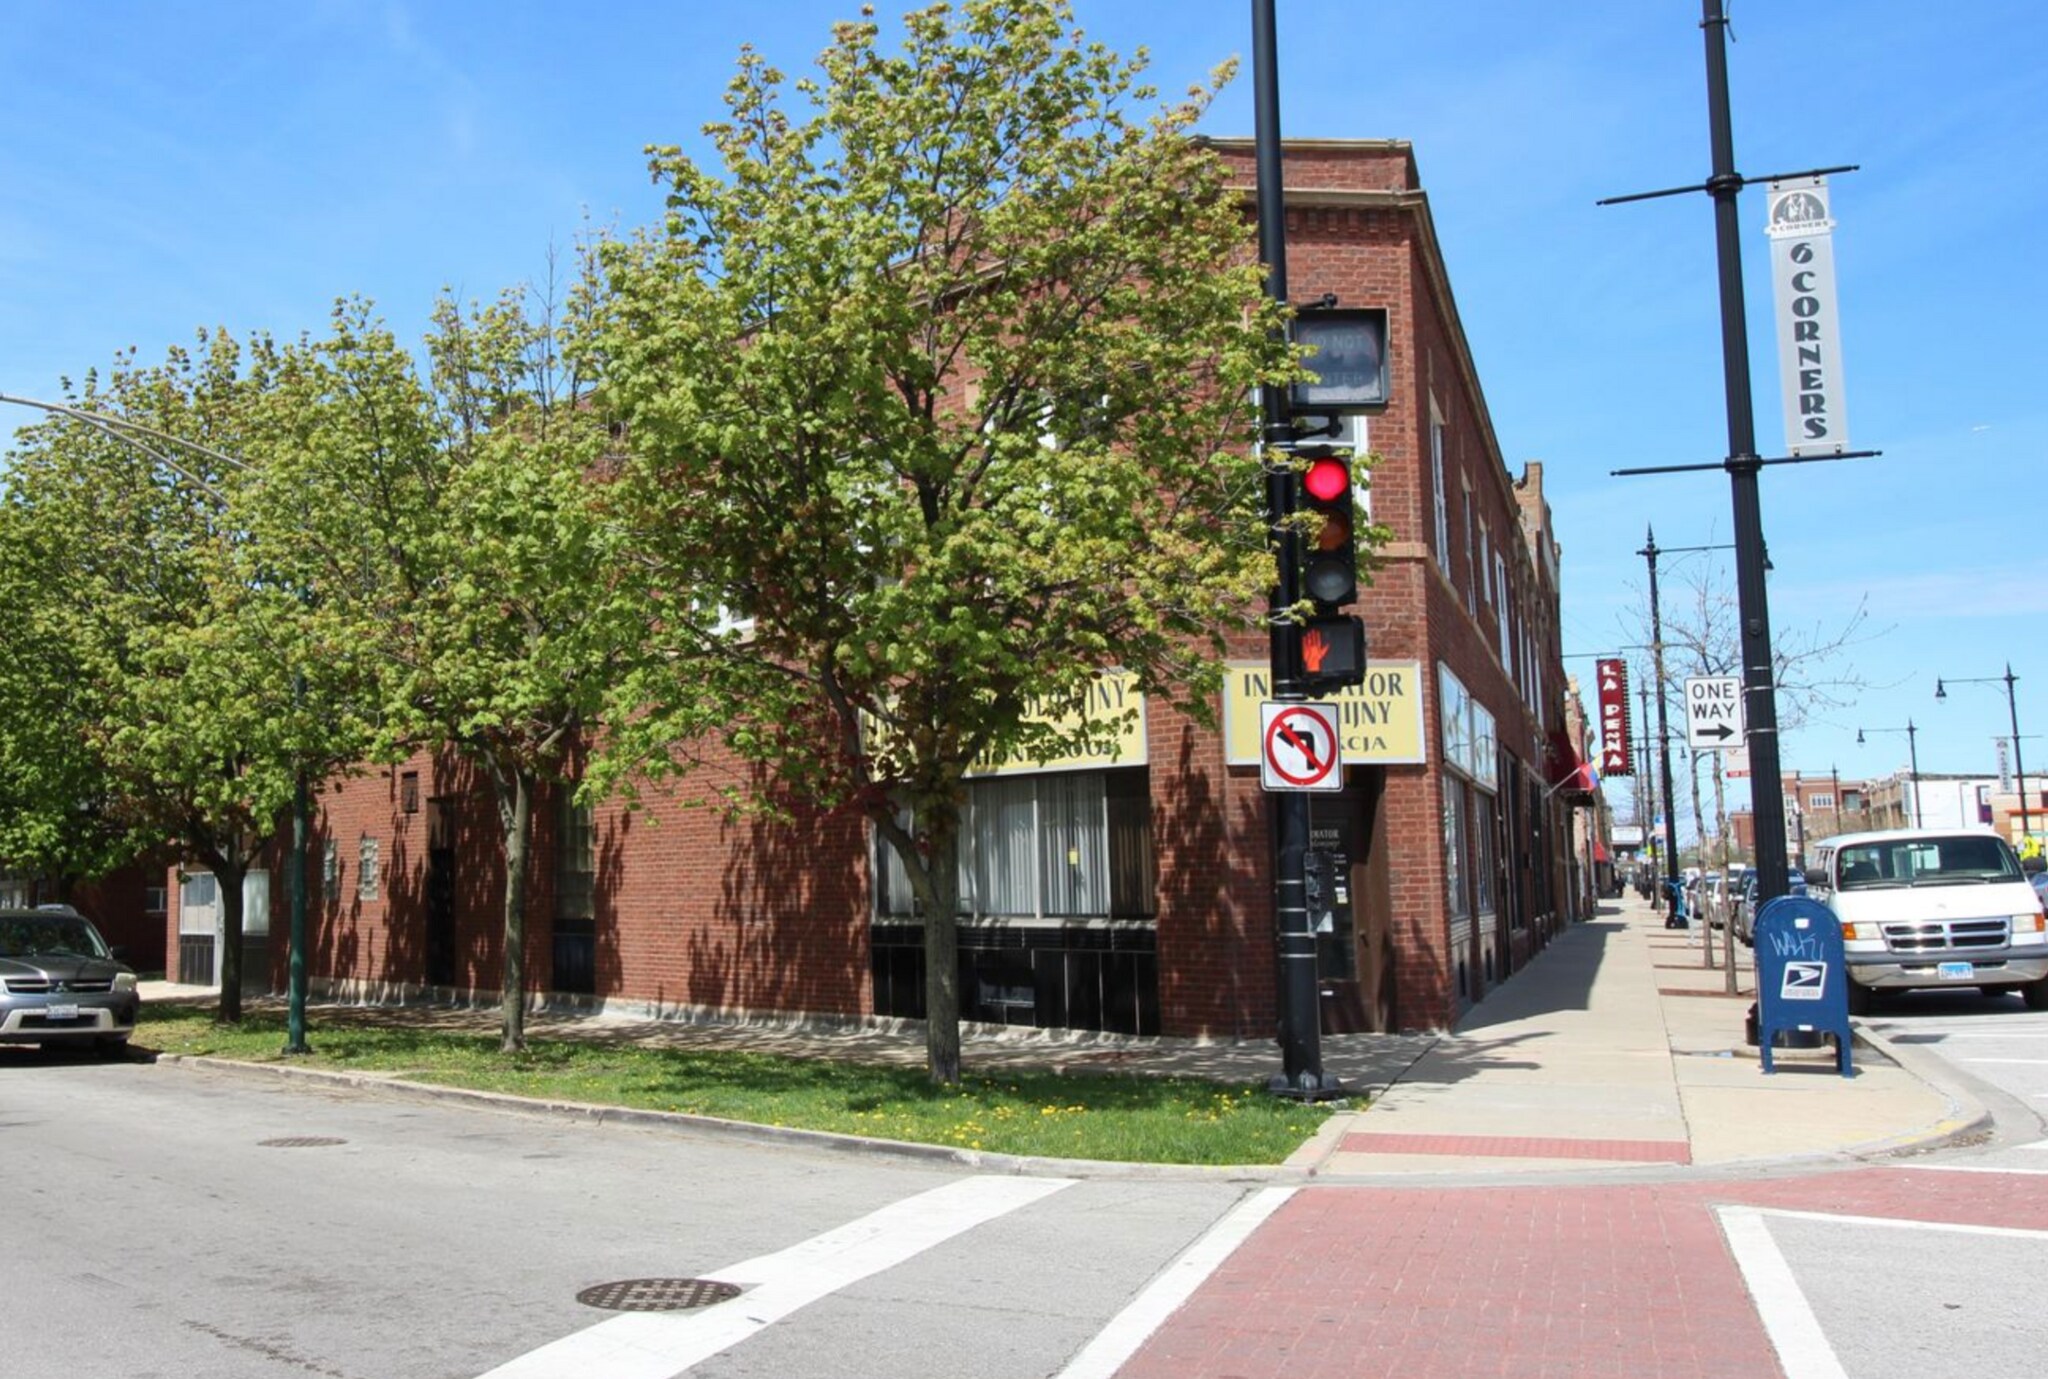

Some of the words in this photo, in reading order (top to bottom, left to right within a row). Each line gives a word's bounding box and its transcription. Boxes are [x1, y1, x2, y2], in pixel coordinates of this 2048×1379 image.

[1790, 242, 1814, 264] 6
[1332, 335, 1363, 349] NOT
[1791, 270, 1828, 440] CORNERS
[1602, 664, 1618, 691] LA
[1692, 682, 1735, 699] ONE
[1692, 702, 1736, 719] WAY
